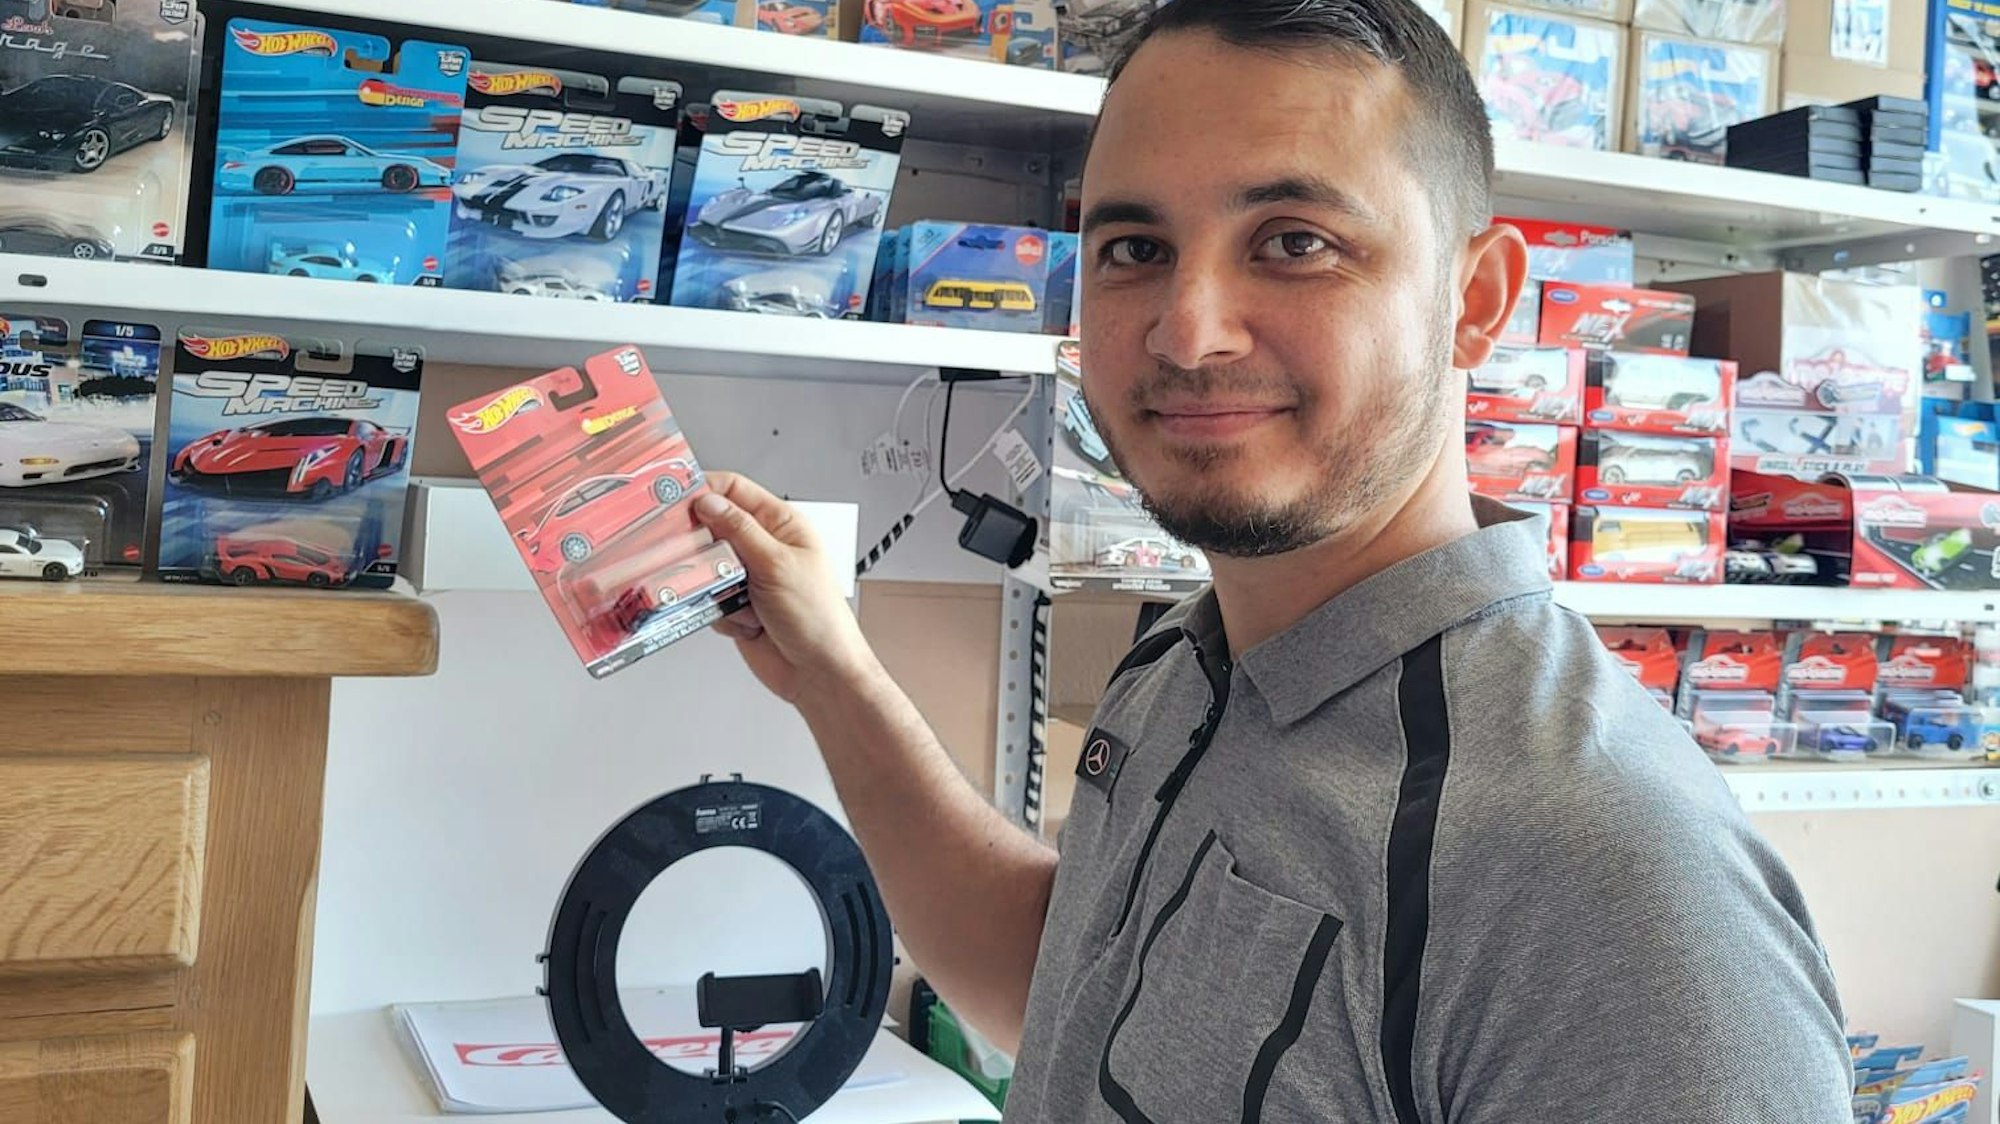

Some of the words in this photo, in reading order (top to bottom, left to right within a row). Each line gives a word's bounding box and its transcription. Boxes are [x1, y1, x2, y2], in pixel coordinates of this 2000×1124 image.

[259, 32, 287, 53] HOT
[287, 30, 332, 51] WHEELS
[490, 73, 516, 92] HOT
[515, 71, 560, 90] WHEELS
[737, 100, 761, 119] HOT
[760, 98, 798, 116] WHEELS
[478, 105, 633, 136] SPEED
[500, 131, 648, 152] MACHINES
[722, 130, 862, 158] SPEED
[738, 154, 872, 173] MACHINES
[114, 324, 135, 338] 1/5
[210, 337, 238, 358] HOT
[238, 334, 286, 355] WHEELS
[195, 370, 369, 402] SPEED
[221, 395, 386, 417] MACHINES
